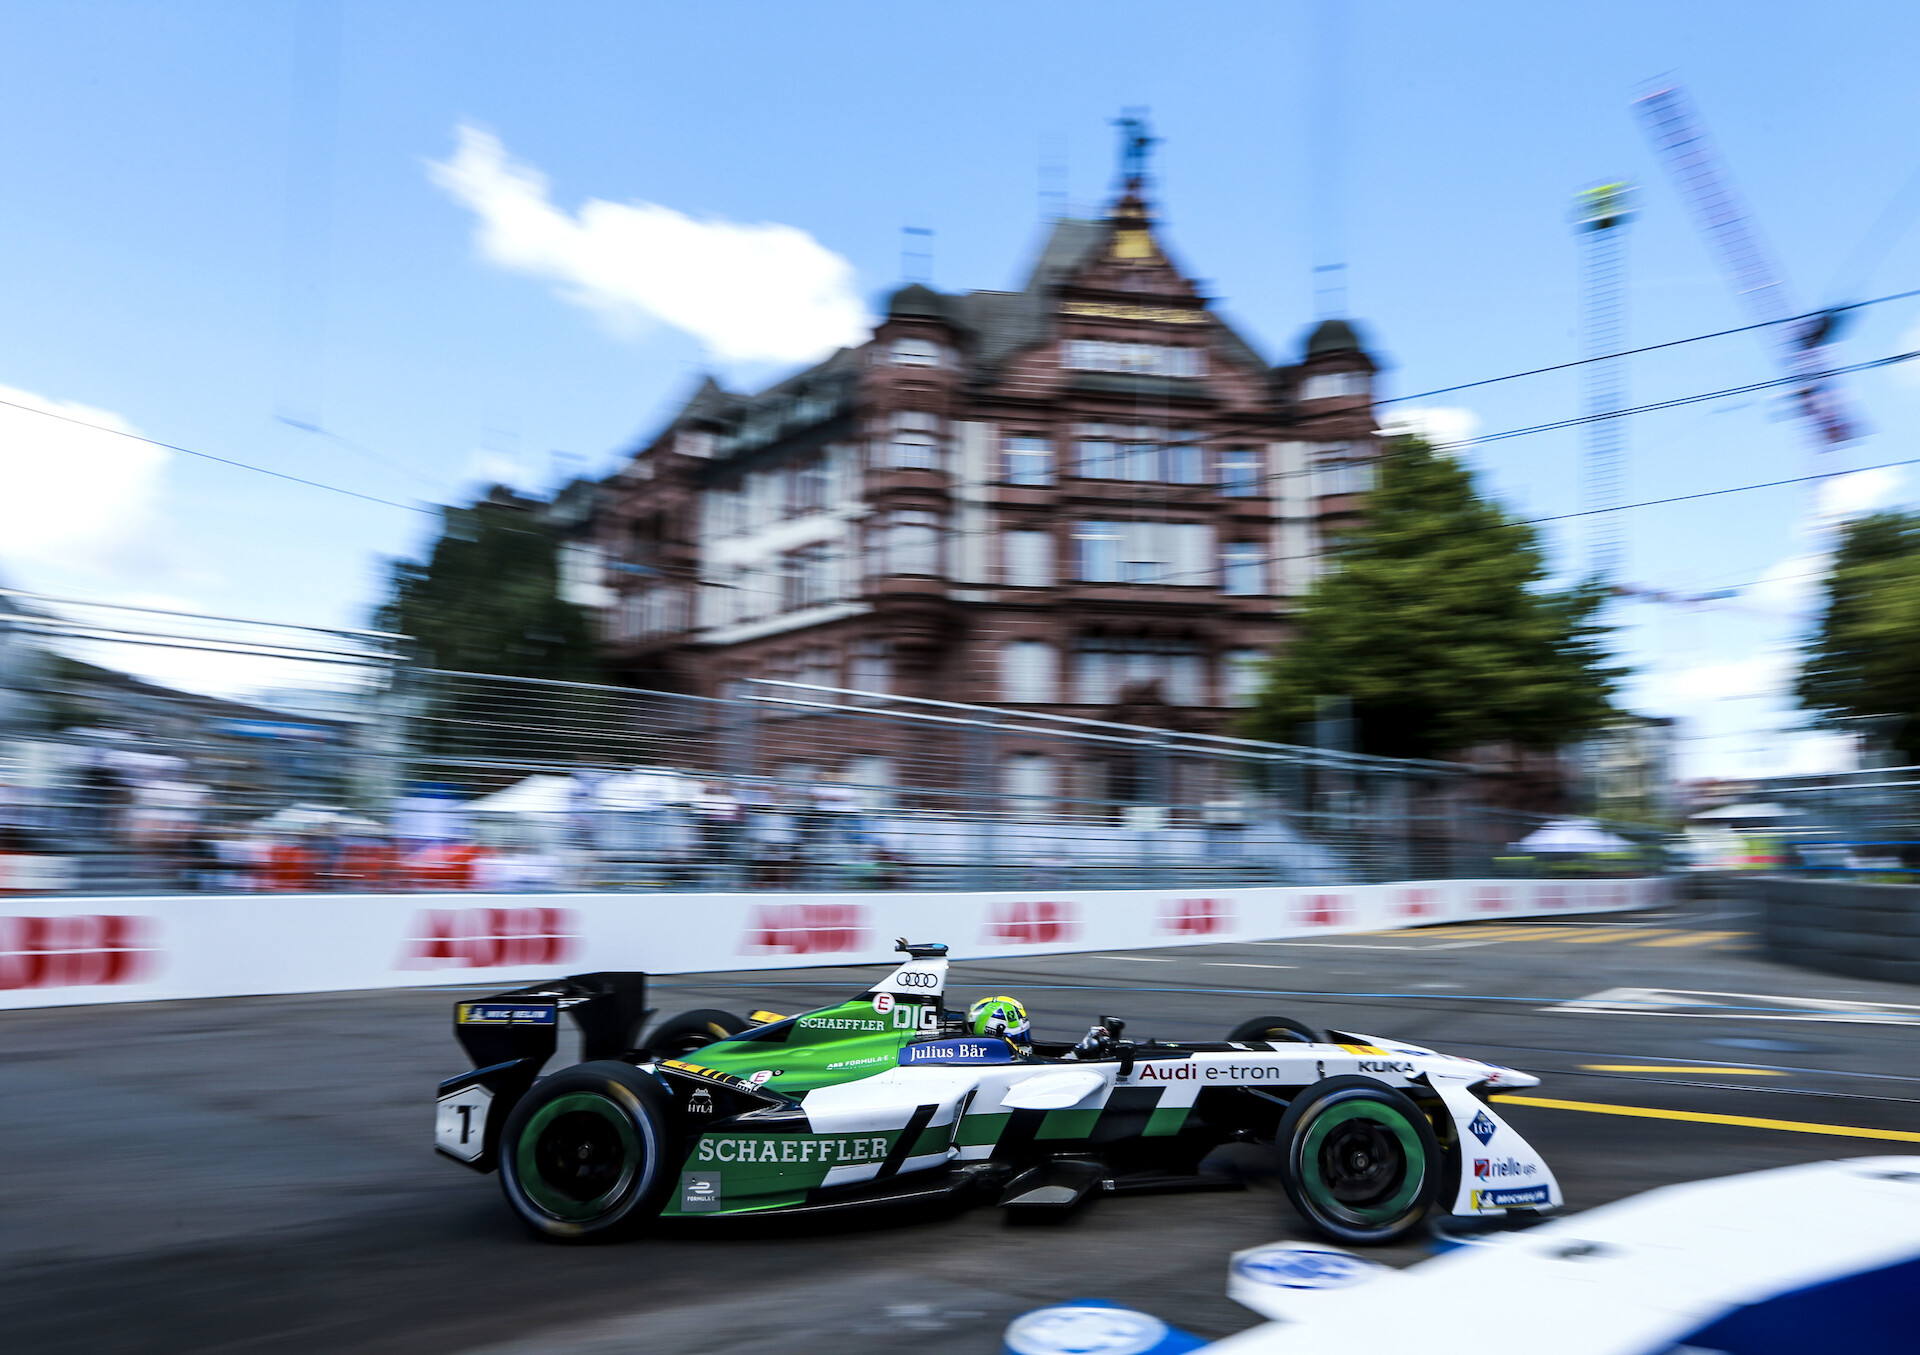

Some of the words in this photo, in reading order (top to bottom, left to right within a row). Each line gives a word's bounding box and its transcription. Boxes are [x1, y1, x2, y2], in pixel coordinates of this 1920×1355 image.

[878, 996, 890, 1011] E
[800, 1017, 885, 1031] SCHAEFFLER
[893, 1005, 938, 1030] DIG
[910, 1045, 954, 1062] Julius
[959, 1044, 987, 1058] Bär
[1139, 1063, 1197, 1080] Audi
[1205, 1064, 1280, 1080] e-tron
[1358, 1060, 1415, 1073] KUKA
[688, 1104, 713, 1114] HYLA
[699, 1138, 888, 1163] SCHAEFFLER
[1492, 1156, 1521, 1177] riello
